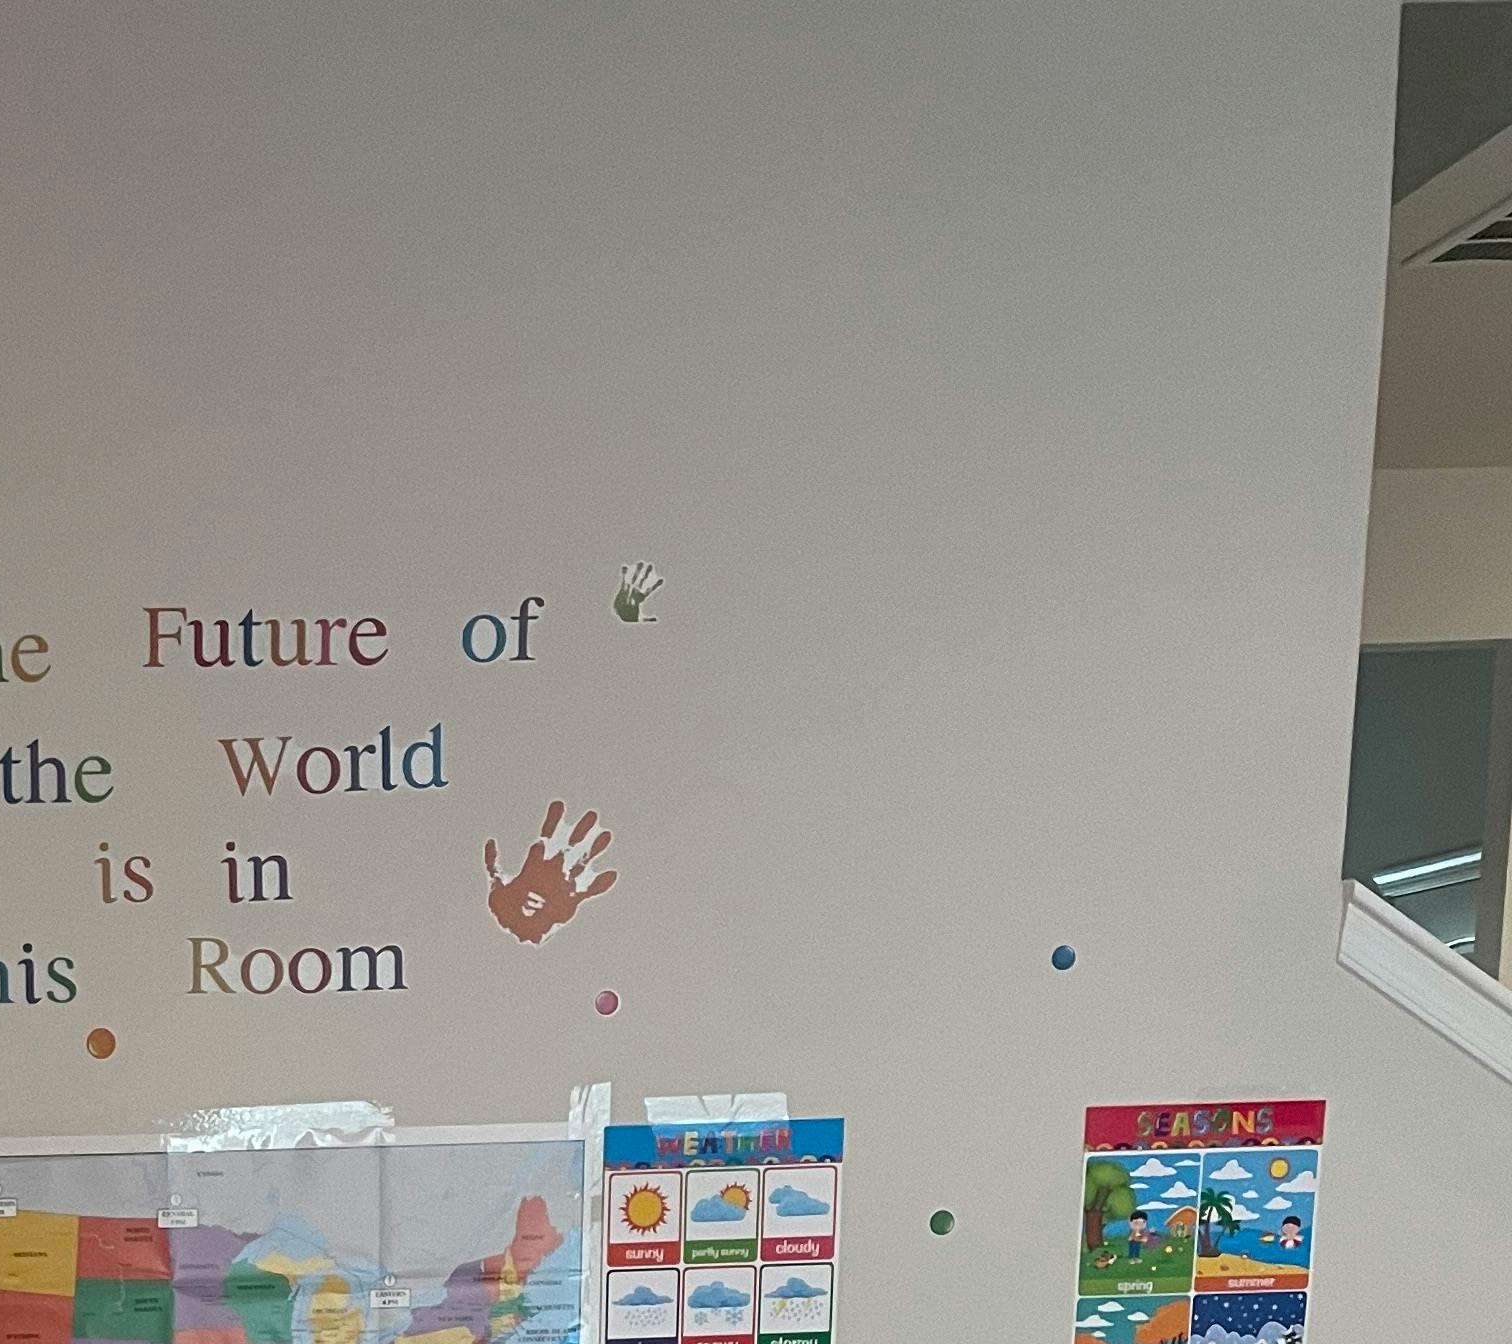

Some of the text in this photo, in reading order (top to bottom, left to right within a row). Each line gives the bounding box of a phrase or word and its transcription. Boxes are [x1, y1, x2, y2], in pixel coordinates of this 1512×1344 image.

[142, 605, 390, 670] Future
[461, 597, 546, 664] of
[218, 723, 449, 797] World
[95, 841, 293, 904] is in
[186, 936, 408, 997] Room
[1137, 1107, 1274, 1137] SEASONS
[656, 1128, 792, 1156] WEATHER
[626, 1248, 664, 1262] sunny
[720, 1246, 749, 1257] sunny
[776, 1241, 820, 1257] cloudy
[1118, 1280, 1153, 1294] spring
[1228, 1277, 1276, 1288] summer
